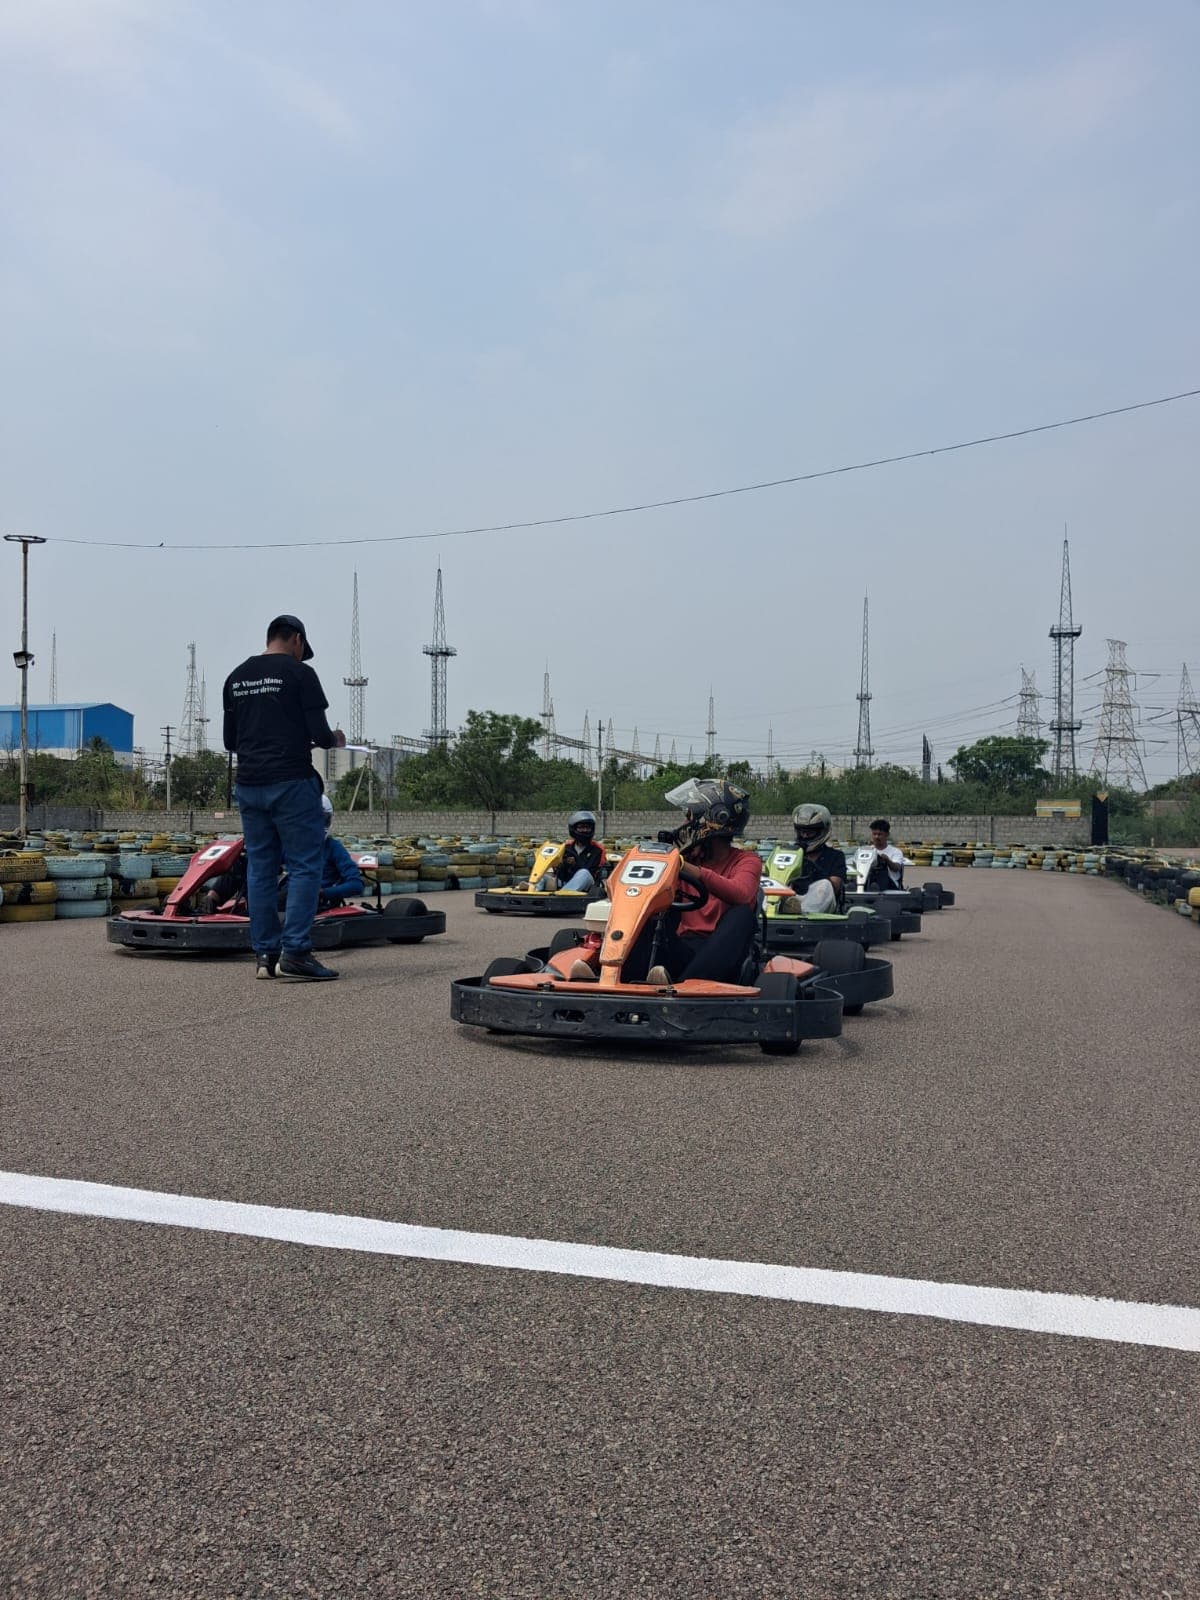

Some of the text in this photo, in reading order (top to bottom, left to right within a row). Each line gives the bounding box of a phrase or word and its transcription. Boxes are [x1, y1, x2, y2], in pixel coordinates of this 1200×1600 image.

[260, 686, 281, 694] driver
[776, 855, 791, 863] 3
[628, 865, 656, 879] 5
